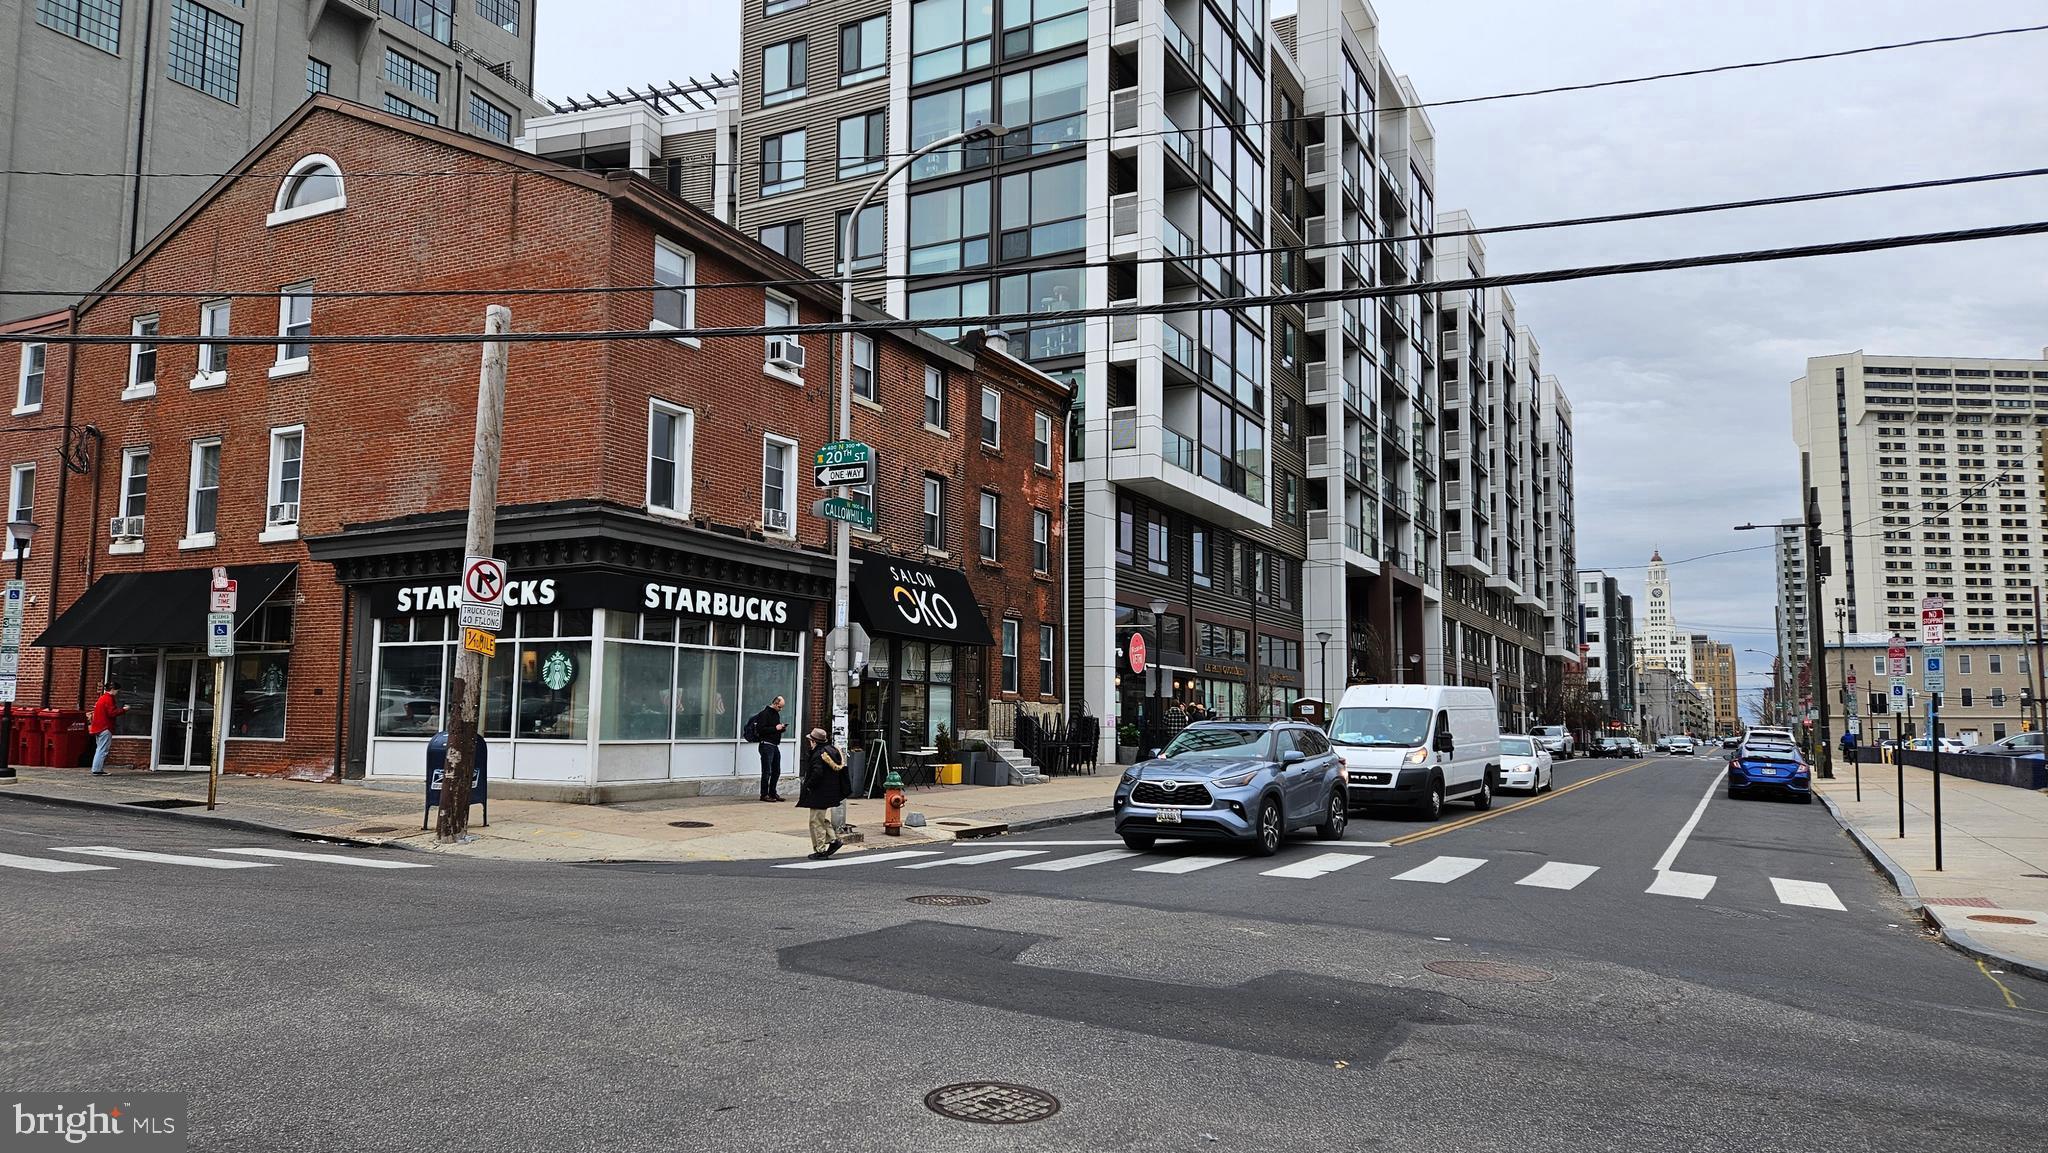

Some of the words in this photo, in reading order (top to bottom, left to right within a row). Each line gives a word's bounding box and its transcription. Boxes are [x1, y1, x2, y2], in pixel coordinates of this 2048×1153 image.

[826, 449, 852, 464] 20TH
[854, 451, 866, 461] ST
[825, 503, 864, 524] CALLOWHILL
[866, 516, 873, 525] ST
[890, 566, 936, 588] SALON
[397, 579, 555, 612] STARCKS
[645, 583, 787, 623] STARBUCKS
[463, 606, 486, 615] TRUCKS
[486, 608, 500, 617] OVER
[893, 586, 957, 629] OKO
[462, 616, 472, 624] 40
[483, 618, 499, 627] LONG
